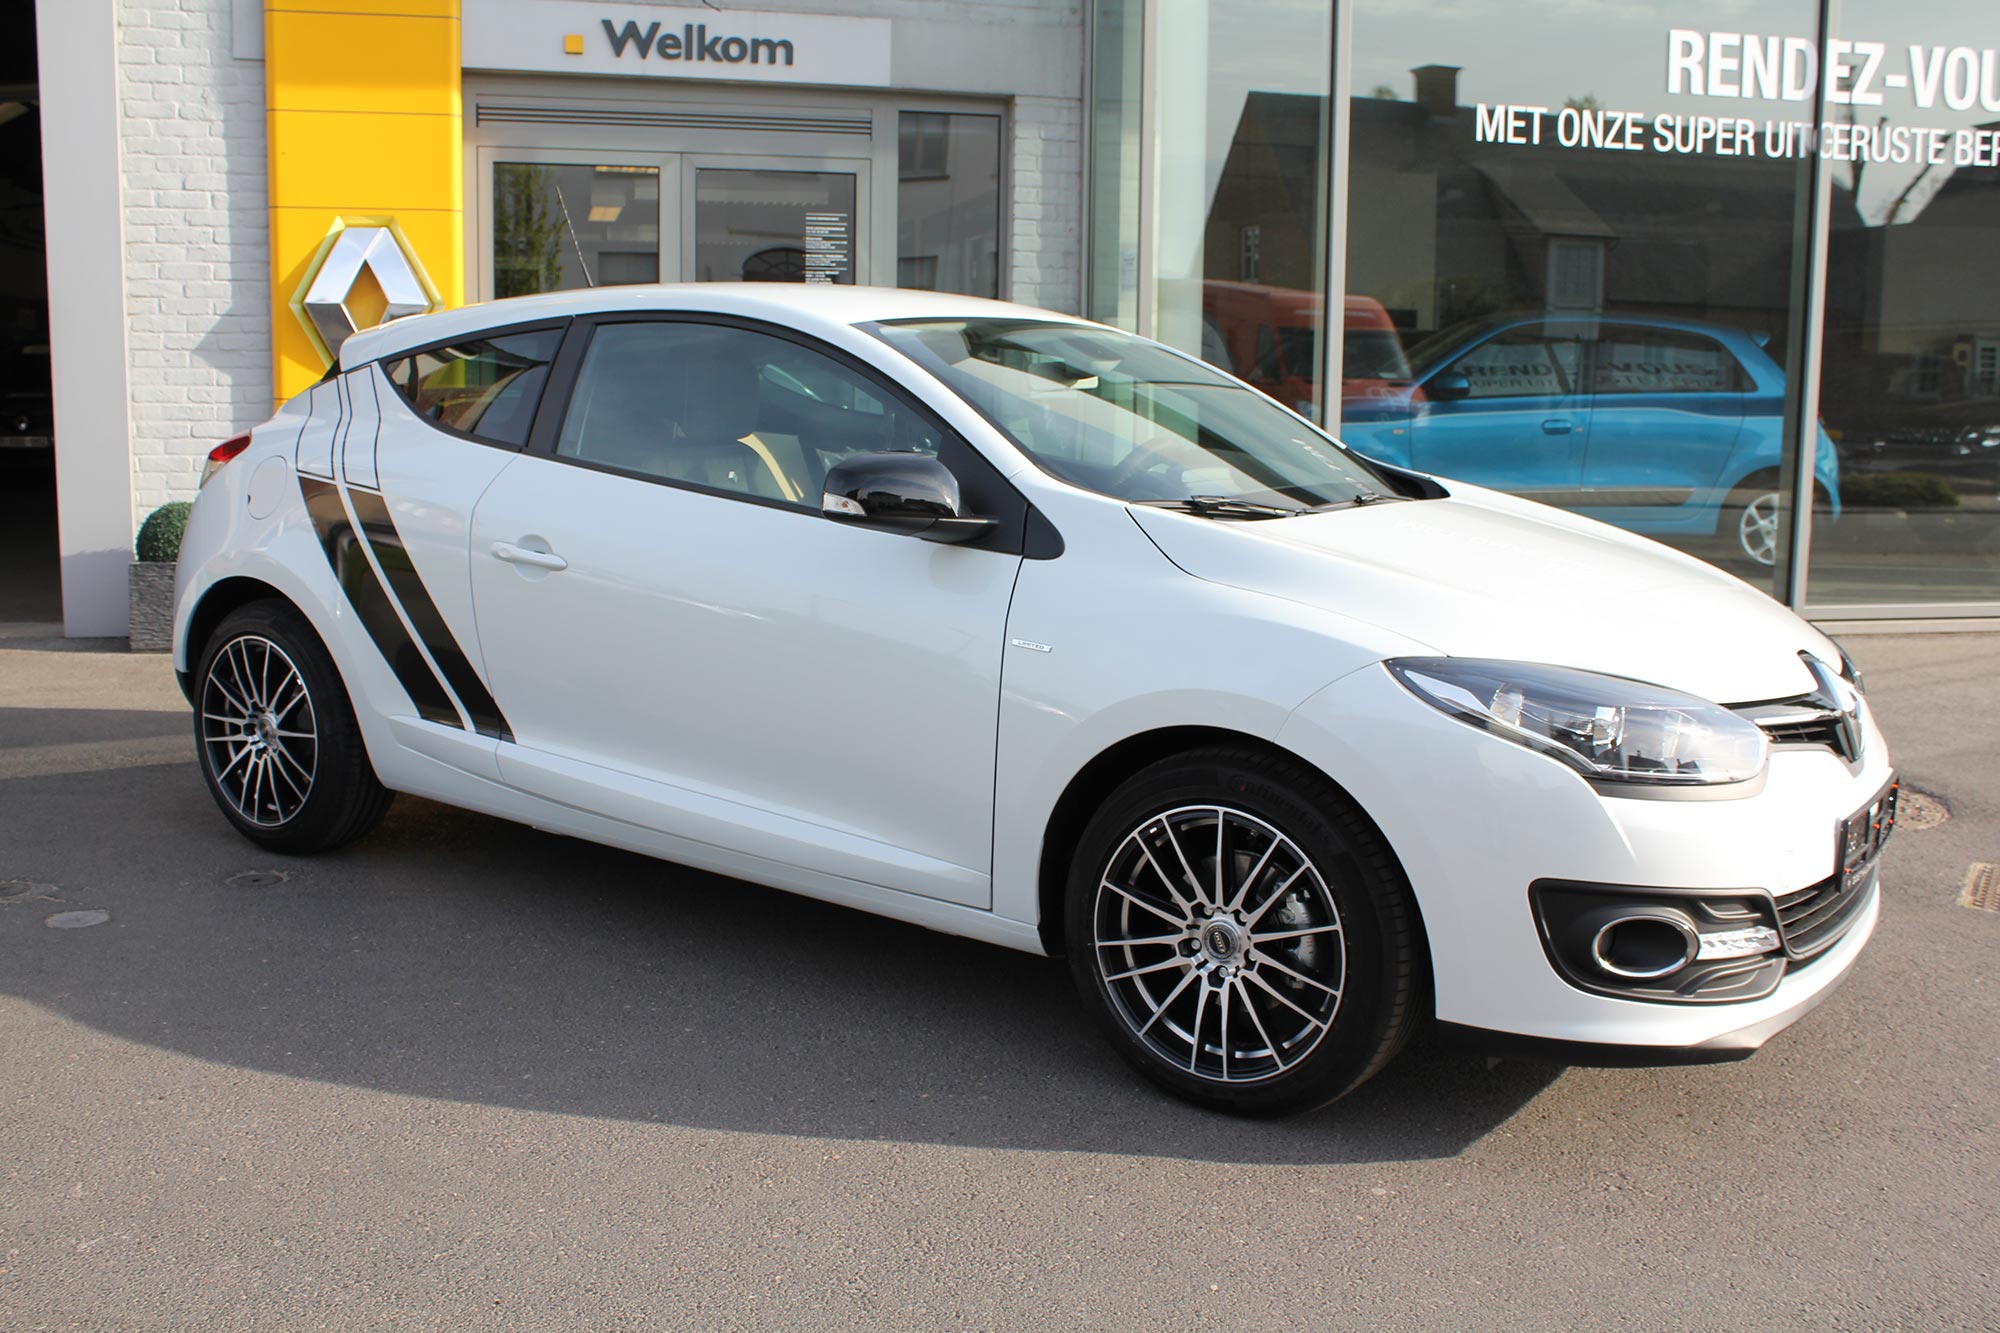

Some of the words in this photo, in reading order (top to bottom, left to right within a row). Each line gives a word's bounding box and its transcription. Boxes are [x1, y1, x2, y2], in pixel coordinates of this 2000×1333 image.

[601, 19, 793, 65] Welkom
[1667, 29, 2000, 112] RENDEZ-VOU
[1475, 103, 1547, 145] MET
[1557, 107, 1644, 150] ONZE
[1653, 114, 1755, 156] SUPER
